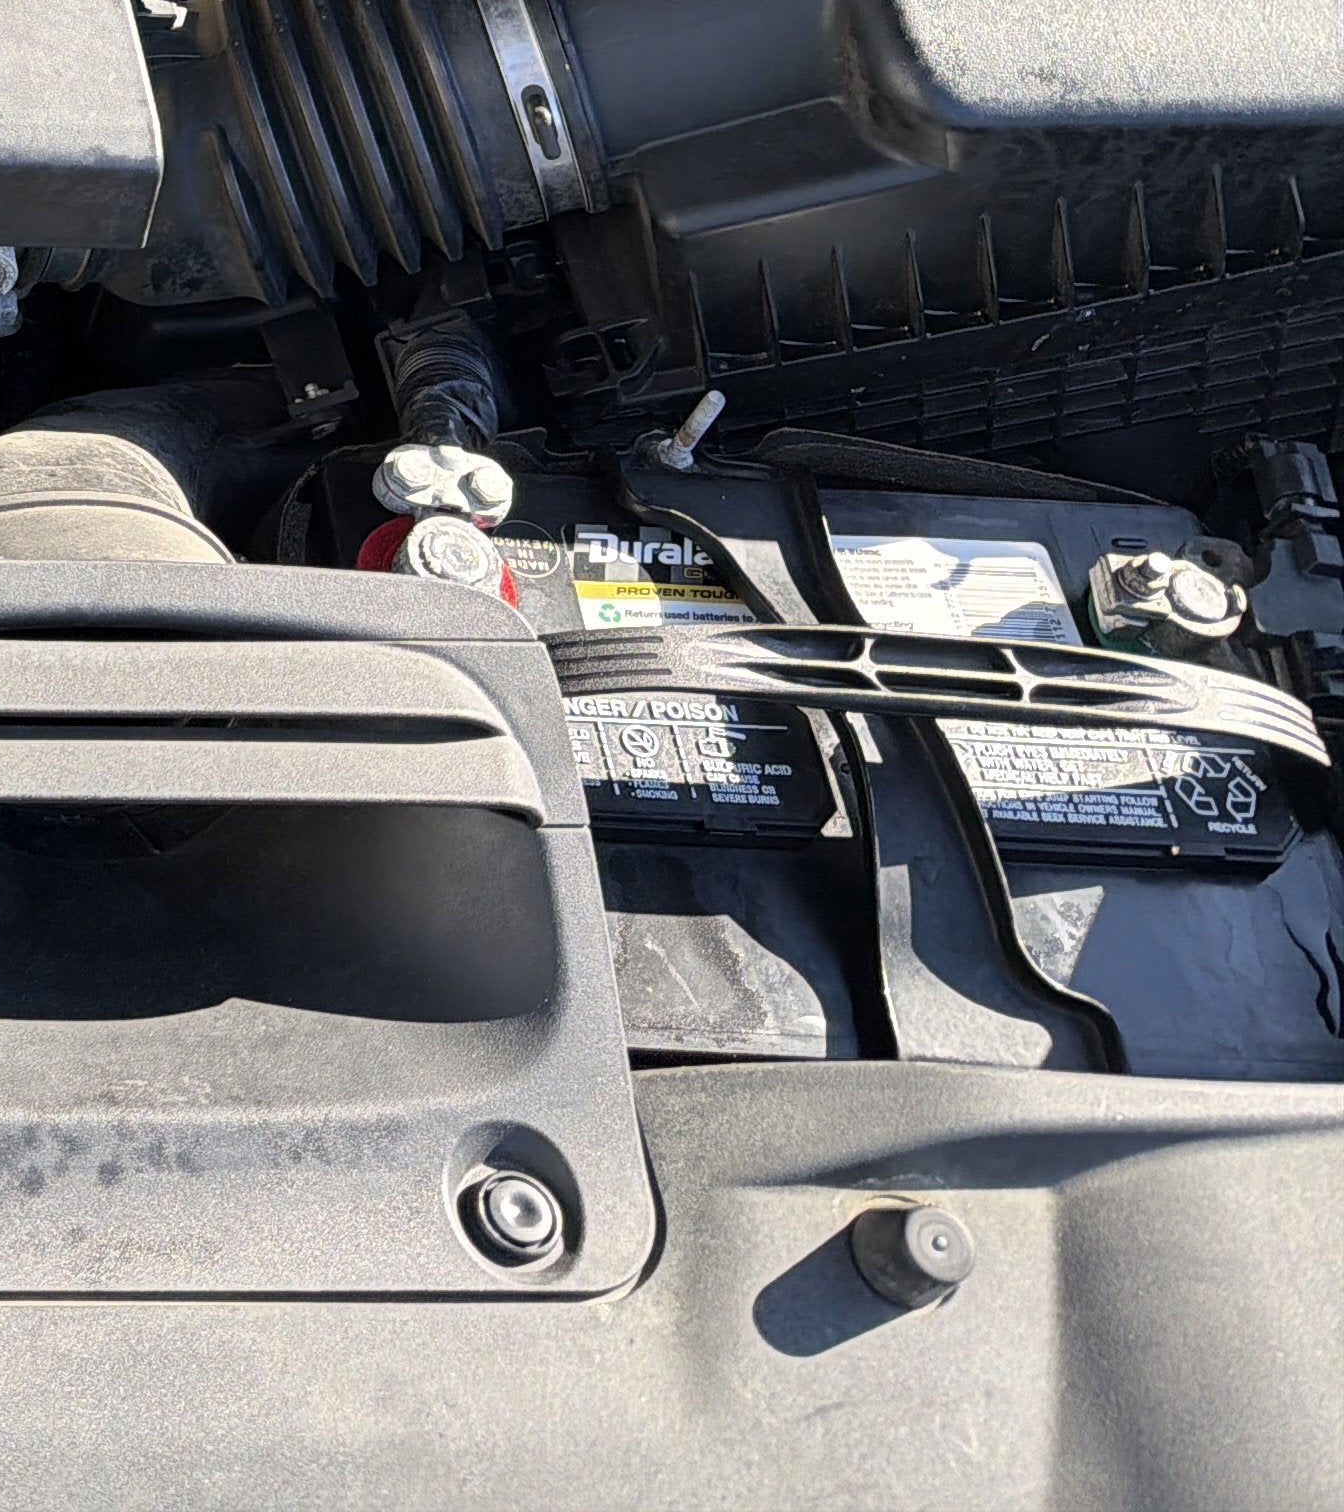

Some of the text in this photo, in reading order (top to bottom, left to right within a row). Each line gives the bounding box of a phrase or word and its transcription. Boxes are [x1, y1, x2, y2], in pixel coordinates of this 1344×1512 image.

[578, 532, 714, 567] Durala
[616, 586, 685, 598] PROVEN
[664, 610, 690, 621] used
[693, 611, 740, 623] batteries
[764, 763, 793, 776] ACID
[711, 793, 749, 804] SEVERE
[1072, 793, 1119, 805] STARTING
[1119, 795, 1159, 807] FOLLOW
[1207, 821, 1258, 835] RECYCLE
